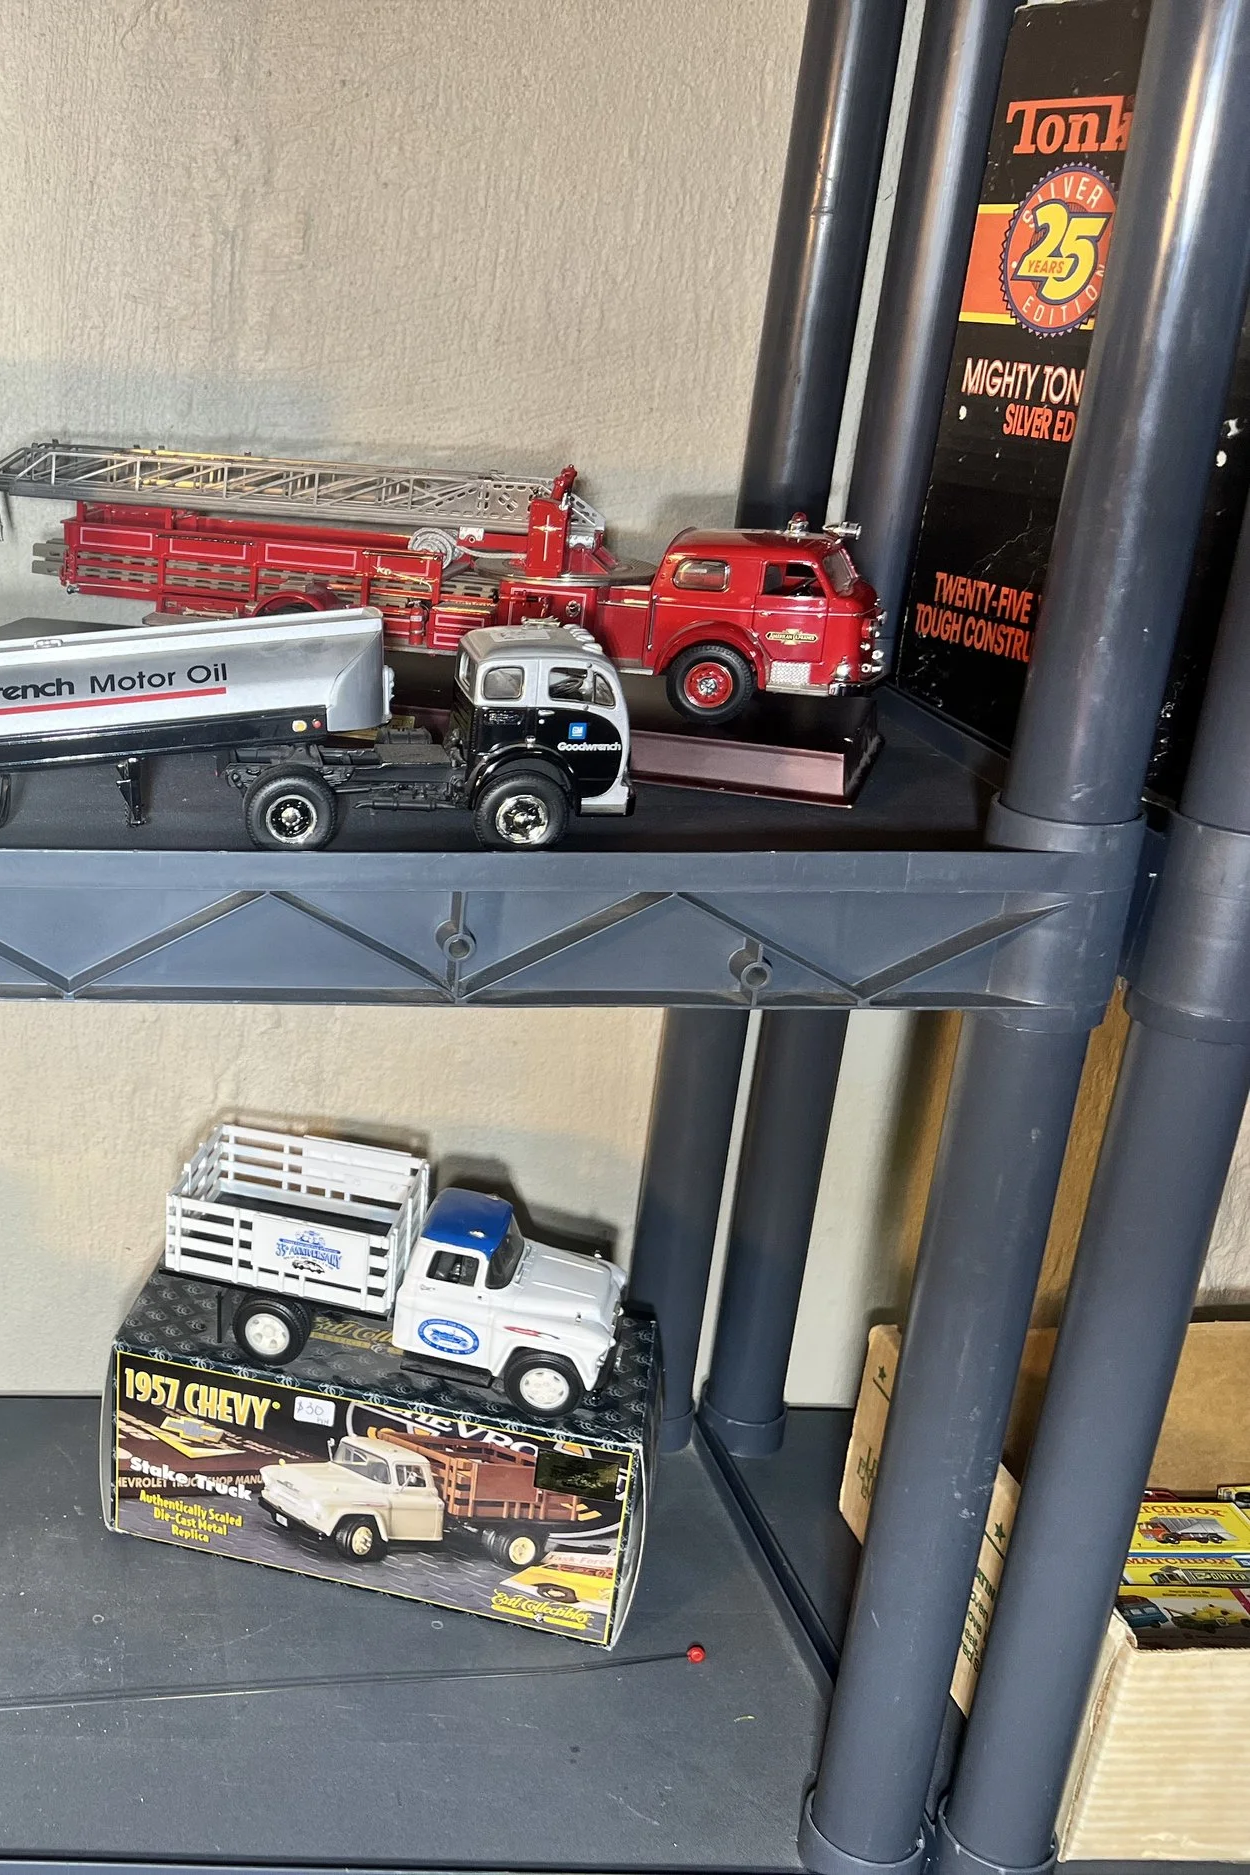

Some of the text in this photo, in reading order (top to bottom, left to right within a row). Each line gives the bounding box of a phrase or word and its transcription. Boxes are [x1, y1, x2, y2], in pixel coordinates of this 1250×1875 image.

[1016, 198, 1109, 301] 25
[1027, 258, 1065, 275] YEARS
[961, 357, 1041, 401] MIGHTY
[1002, 403, 1053, 440] SILVER
[934, 571, 1034, 624] TWENTY-FIVE
[915, 603, 963, 643] TOUGH
[89, 669, 176, 694] Motor
[186, 663, 228, 684] Oil
[557, 741, 622, 752] Goodwrench
[124, 1368, 271, 1430] 1957 CHEVY
[129, 1456, 253, 1501] Stake Truck
[139, 1489, 208, 1521] Authentically
[208, 1507, 244, 1528] Scaled
[153, 1506, 228, 1537] Die-Cast Metal
[171, 1525, 210, 1543] Replica
[1126, 1556, 1232, 1566] MATCHBOX
[520, 1598, 589, 1624] Collectibles
